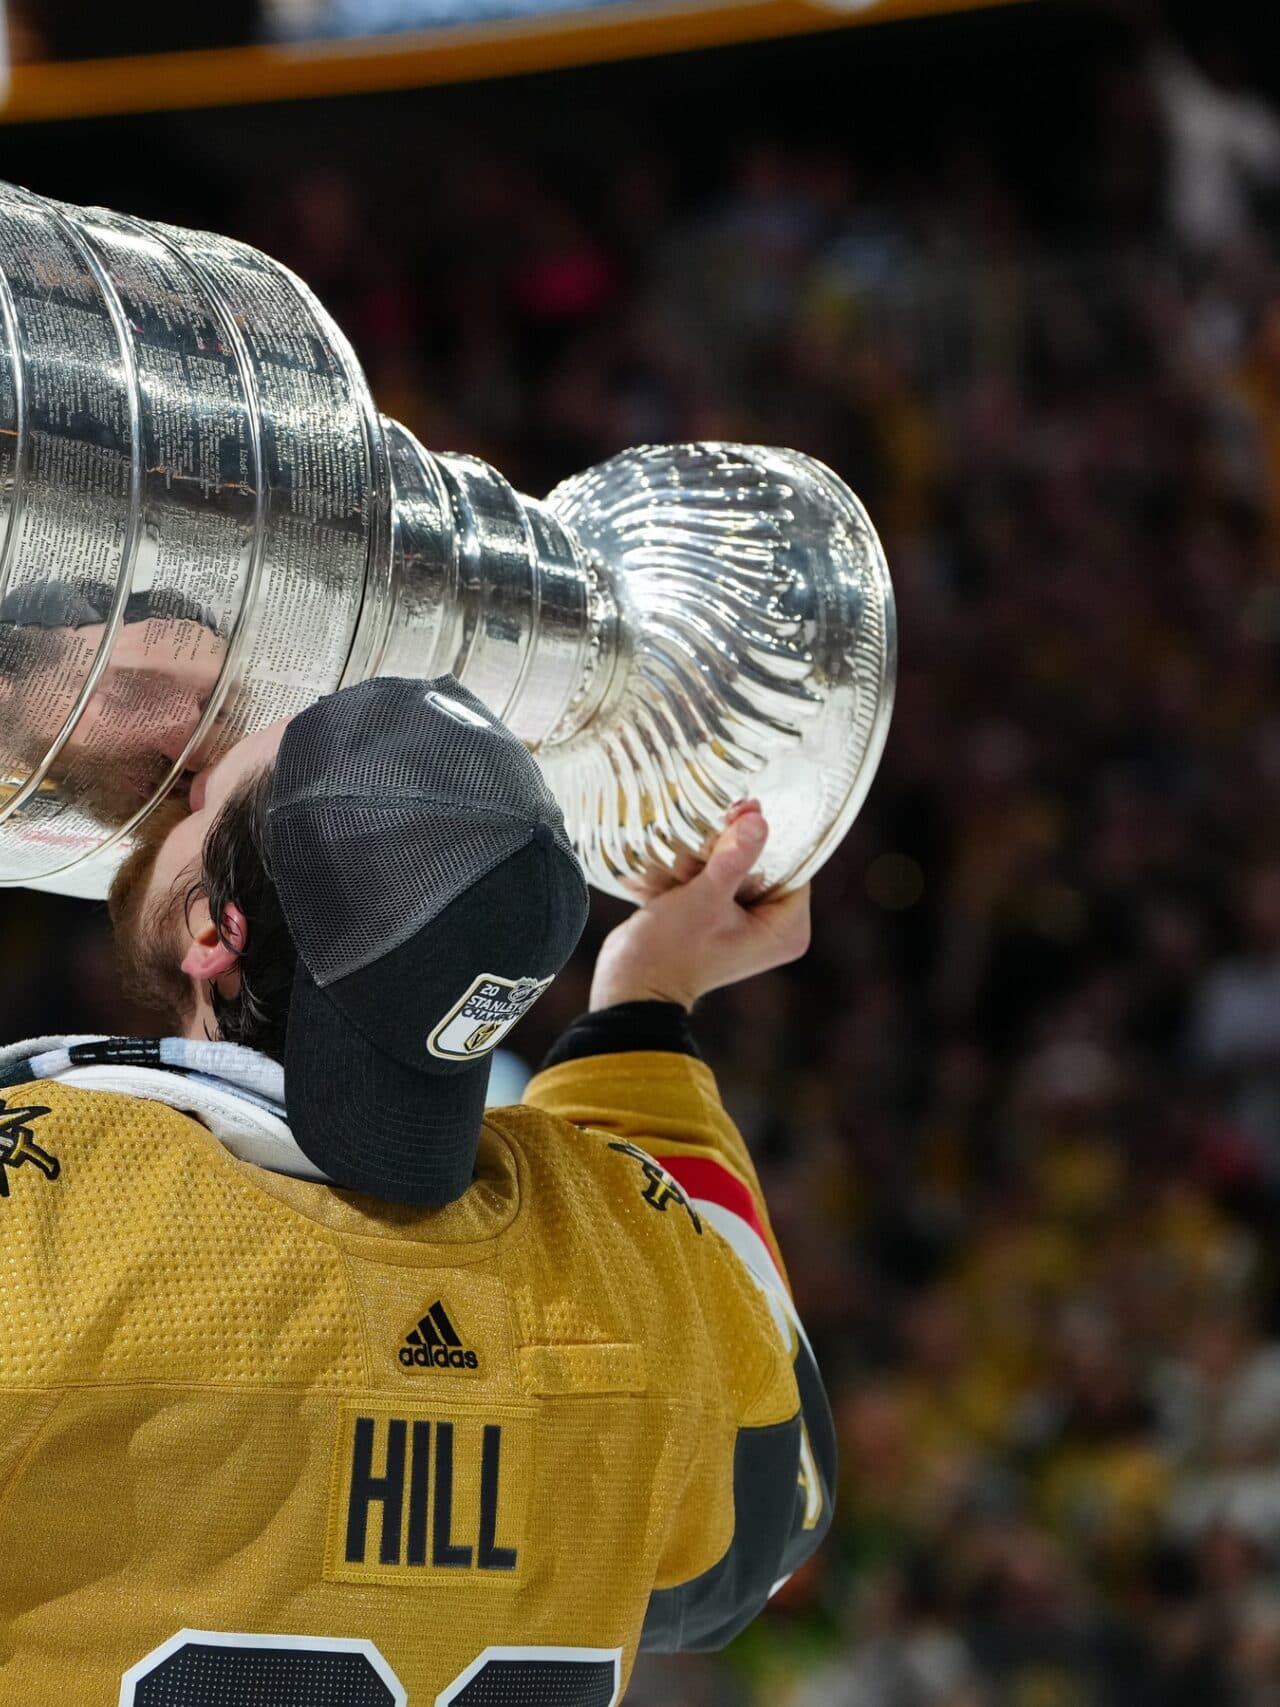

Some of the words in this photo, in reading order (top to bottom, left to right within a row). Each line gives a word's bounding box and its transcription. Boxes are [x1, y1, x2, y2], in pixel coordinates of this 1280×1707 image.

[479, 983, 500, 997] 20
[398, 1343, 479, 1370] adidas
[344, 1415, 519, 1571] HILL
